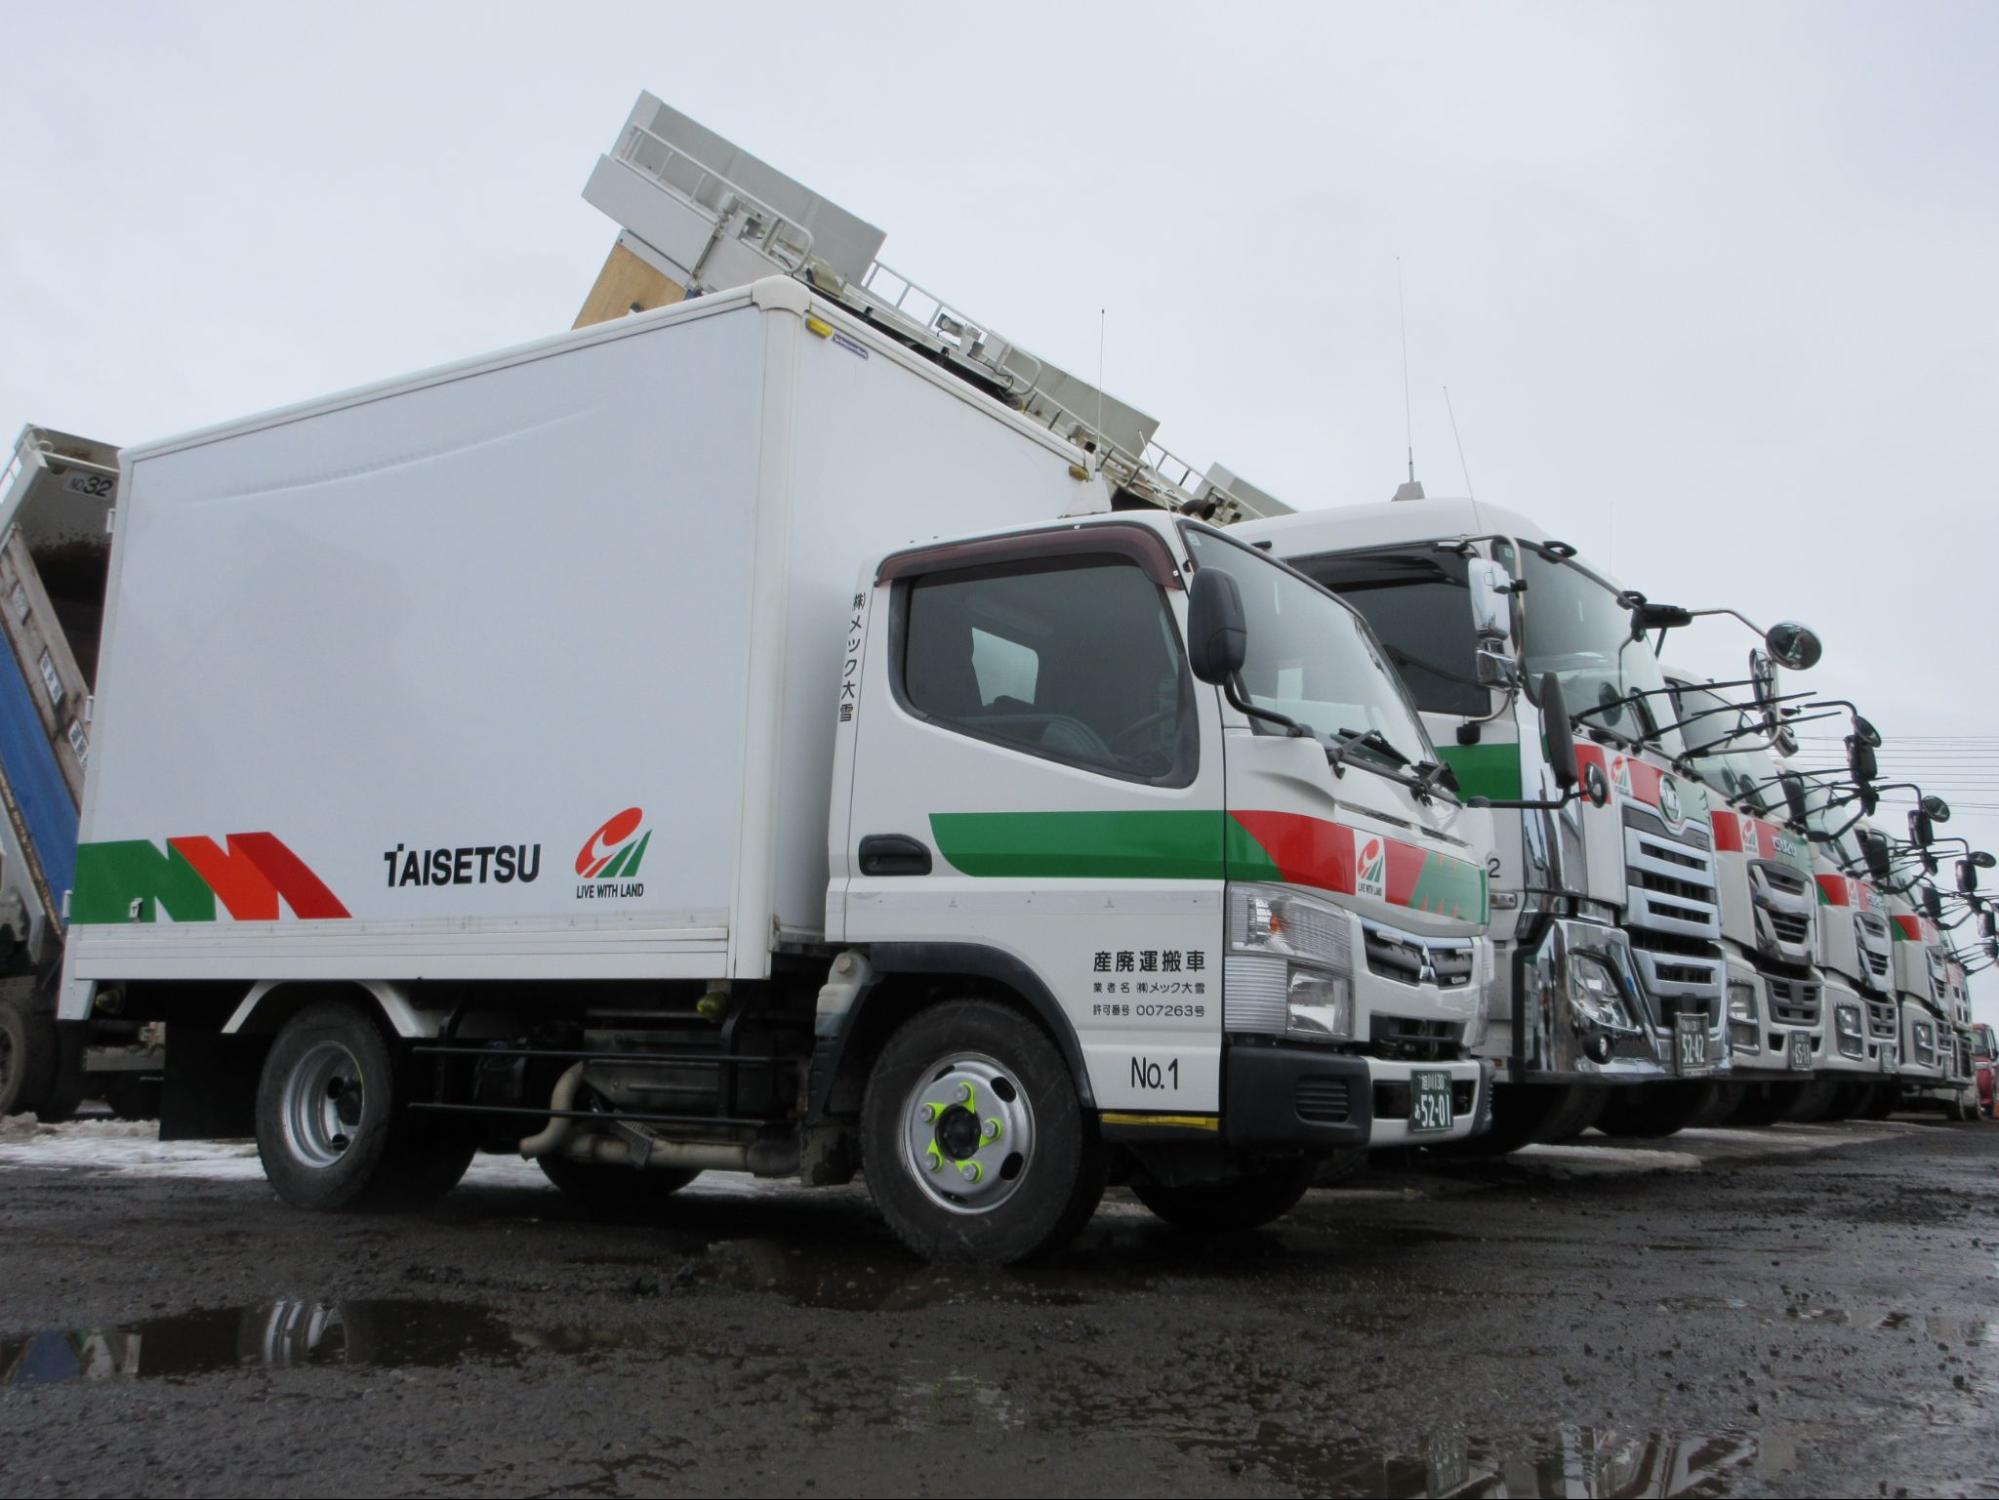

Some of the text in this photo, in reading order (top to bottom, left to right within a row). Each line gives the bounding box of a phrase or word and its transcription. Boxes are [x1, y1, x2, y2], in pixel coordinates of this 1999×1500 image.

[384, 843, 541, 887] TAISETSU
[576, 883, 644, 899] LIVE WITH LAND
[1093, 950, 1205, 972] 産廃運搬車
[1093, 1004, 1205, 1017] 許可番号 007263号
[1131, 1056, 1178, 1090] No.1
